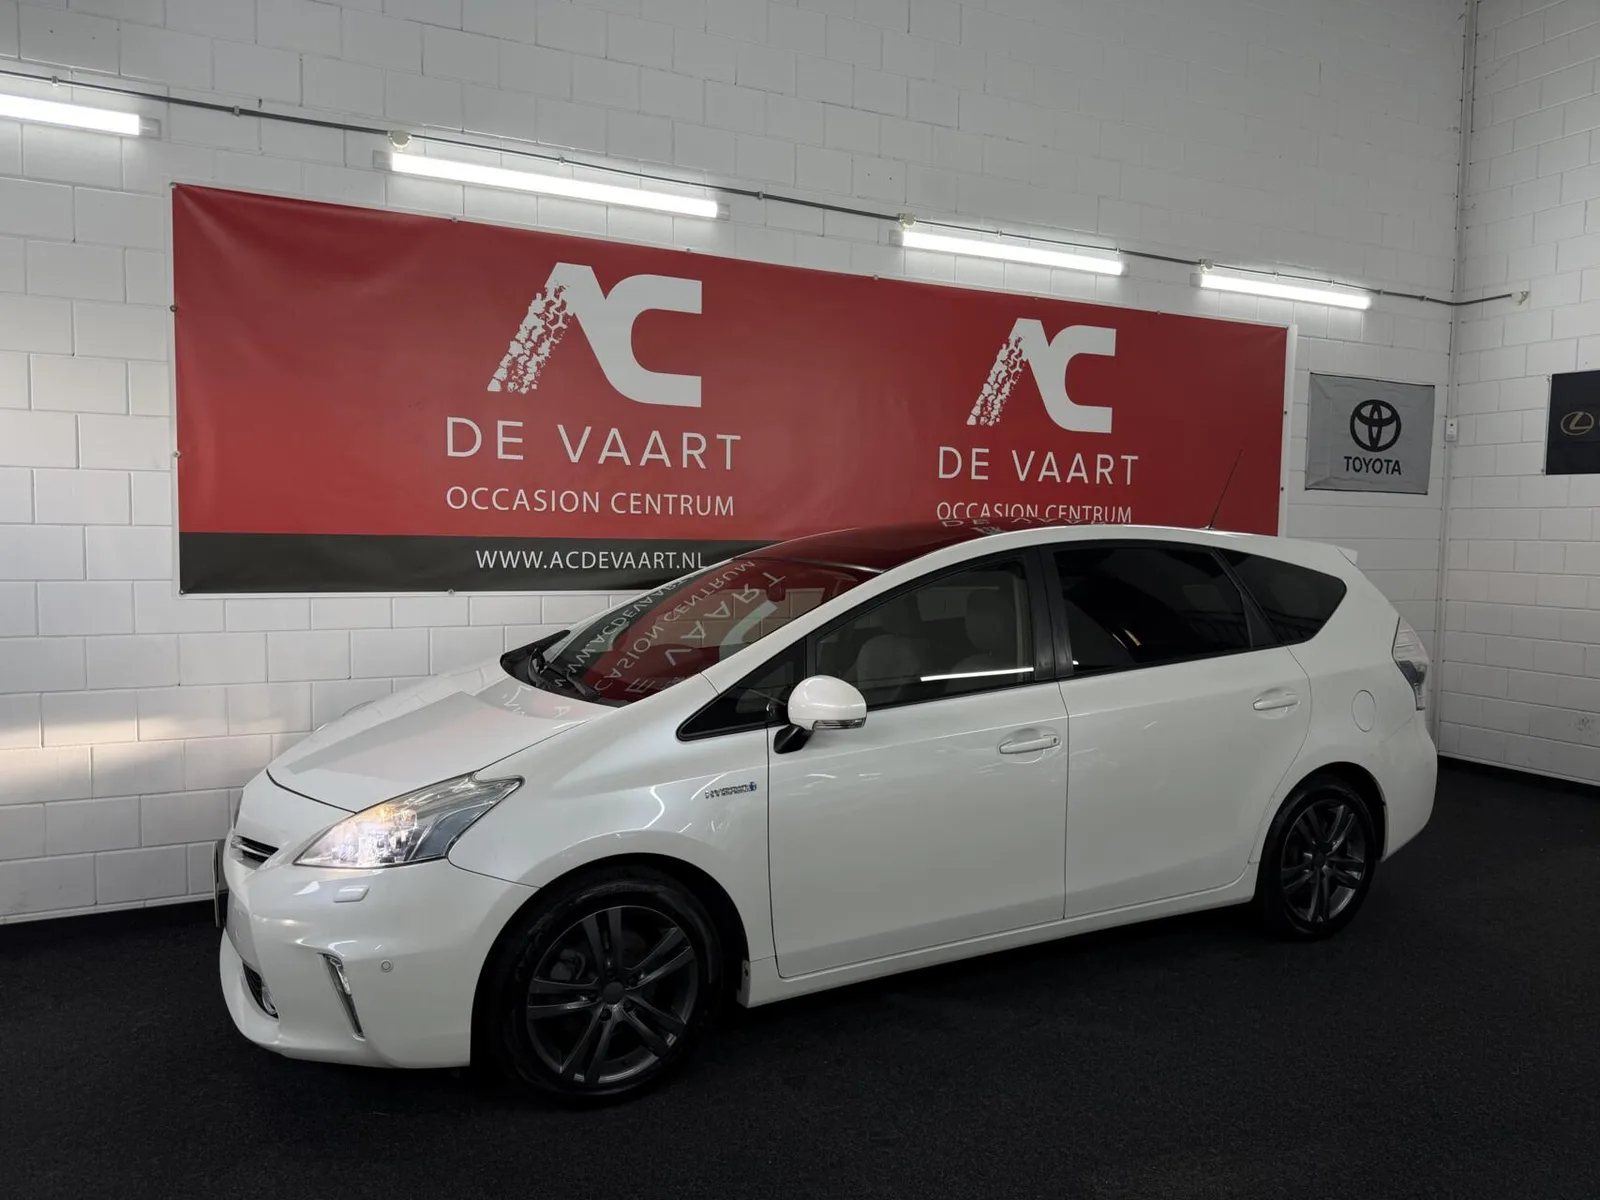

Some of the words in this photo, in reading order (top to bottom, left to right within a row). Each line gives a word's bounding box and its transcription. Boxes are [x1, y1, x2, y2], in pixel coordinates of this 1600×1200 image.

[487, 262, 702, 407] AC
[966, 317, 1116, 433] AC
[447, 416, 524, 460] DE
[557, 424, 741, 470] VAART
[938, 446, 989, 480] DE
[1011, 449, 1139, 485] VAART
[1343, 456, 1402, 475] TOYOTA
[446, 487, 600, 513] OCCASION
[610, 492, 734, 516] CENTRUM
[937, 502, 1038, 519] OCCASION
[1045, 505, 1132, 524] CENTRUM
[475, 550, 707, 569] WWW.ACDEVAART.NL
